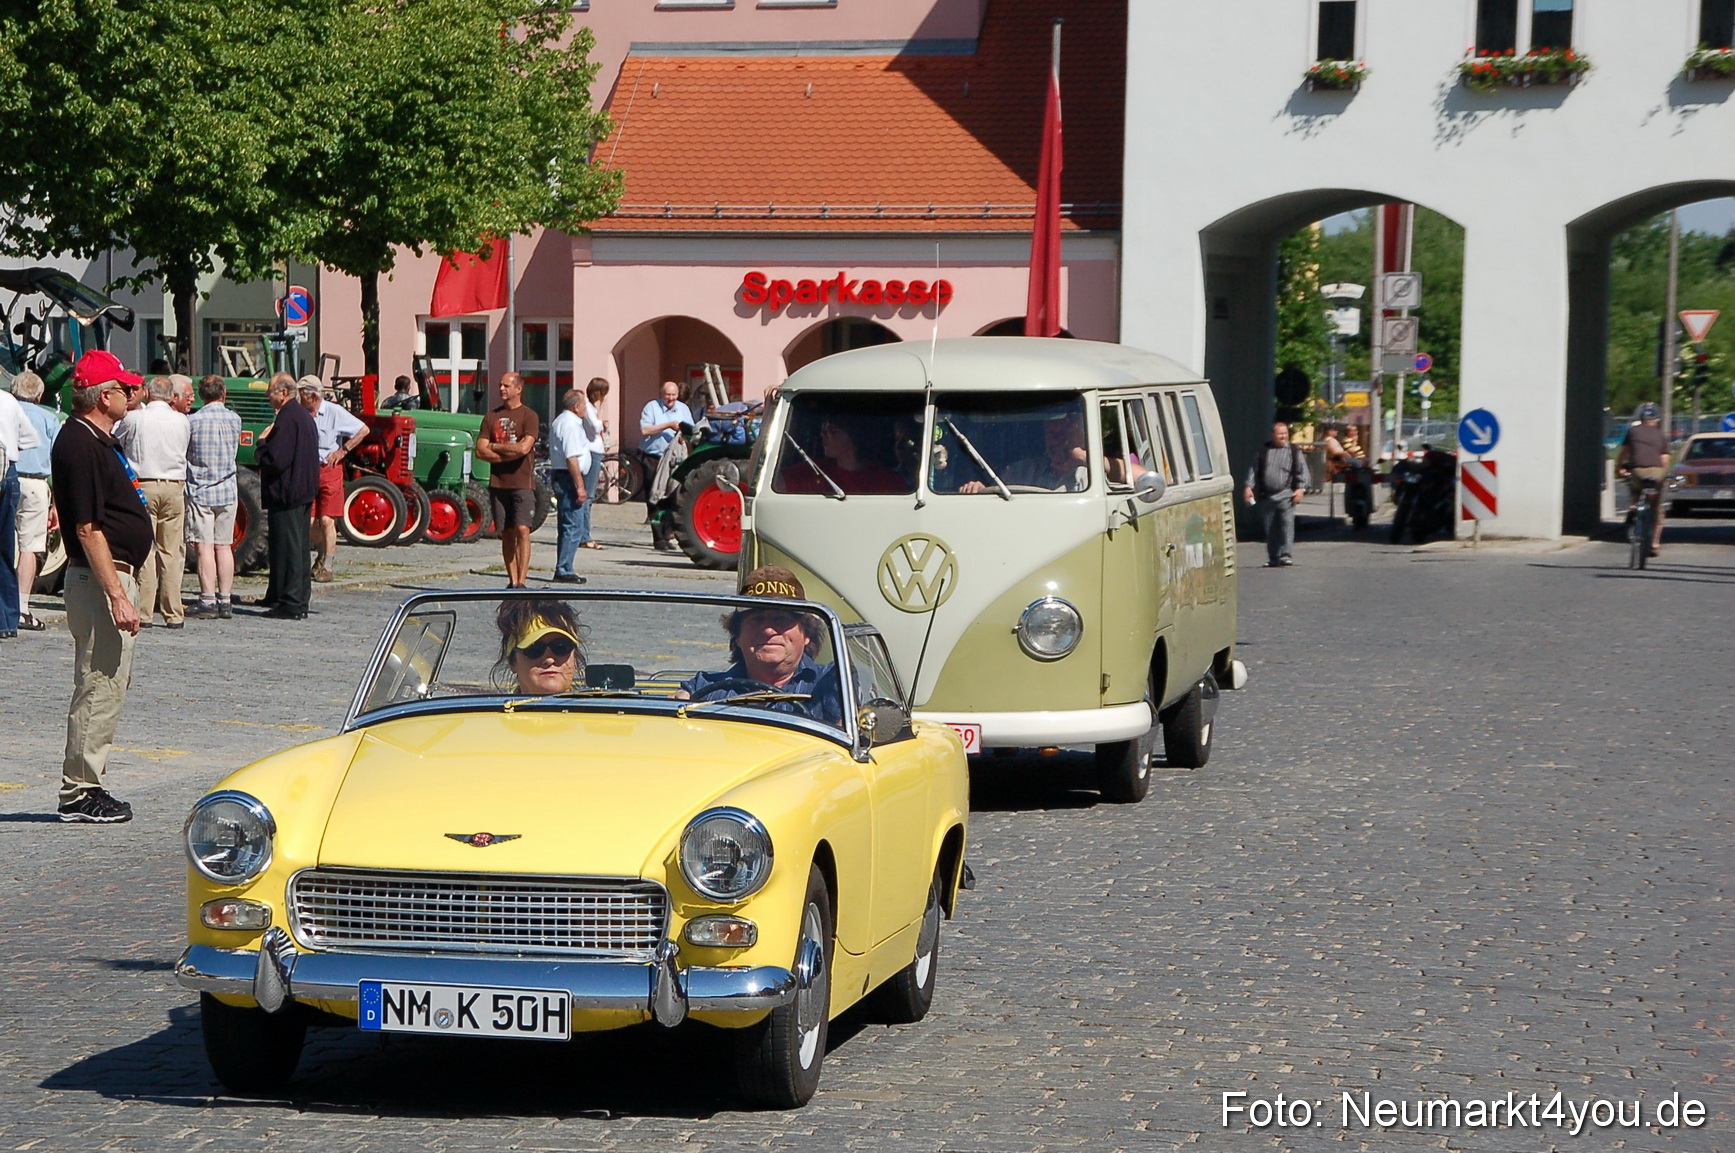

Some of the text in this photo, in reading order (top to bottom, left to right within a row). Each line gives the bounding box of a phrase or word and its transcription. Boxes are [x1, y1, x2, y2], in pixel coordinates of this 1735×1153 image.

[742, 271, 954, 311] Sparkasse
[877, 532, 959, 614] VW
[366, 1009, 375, 1021] D
[382, 988, 566, 1034] NM K 50H
